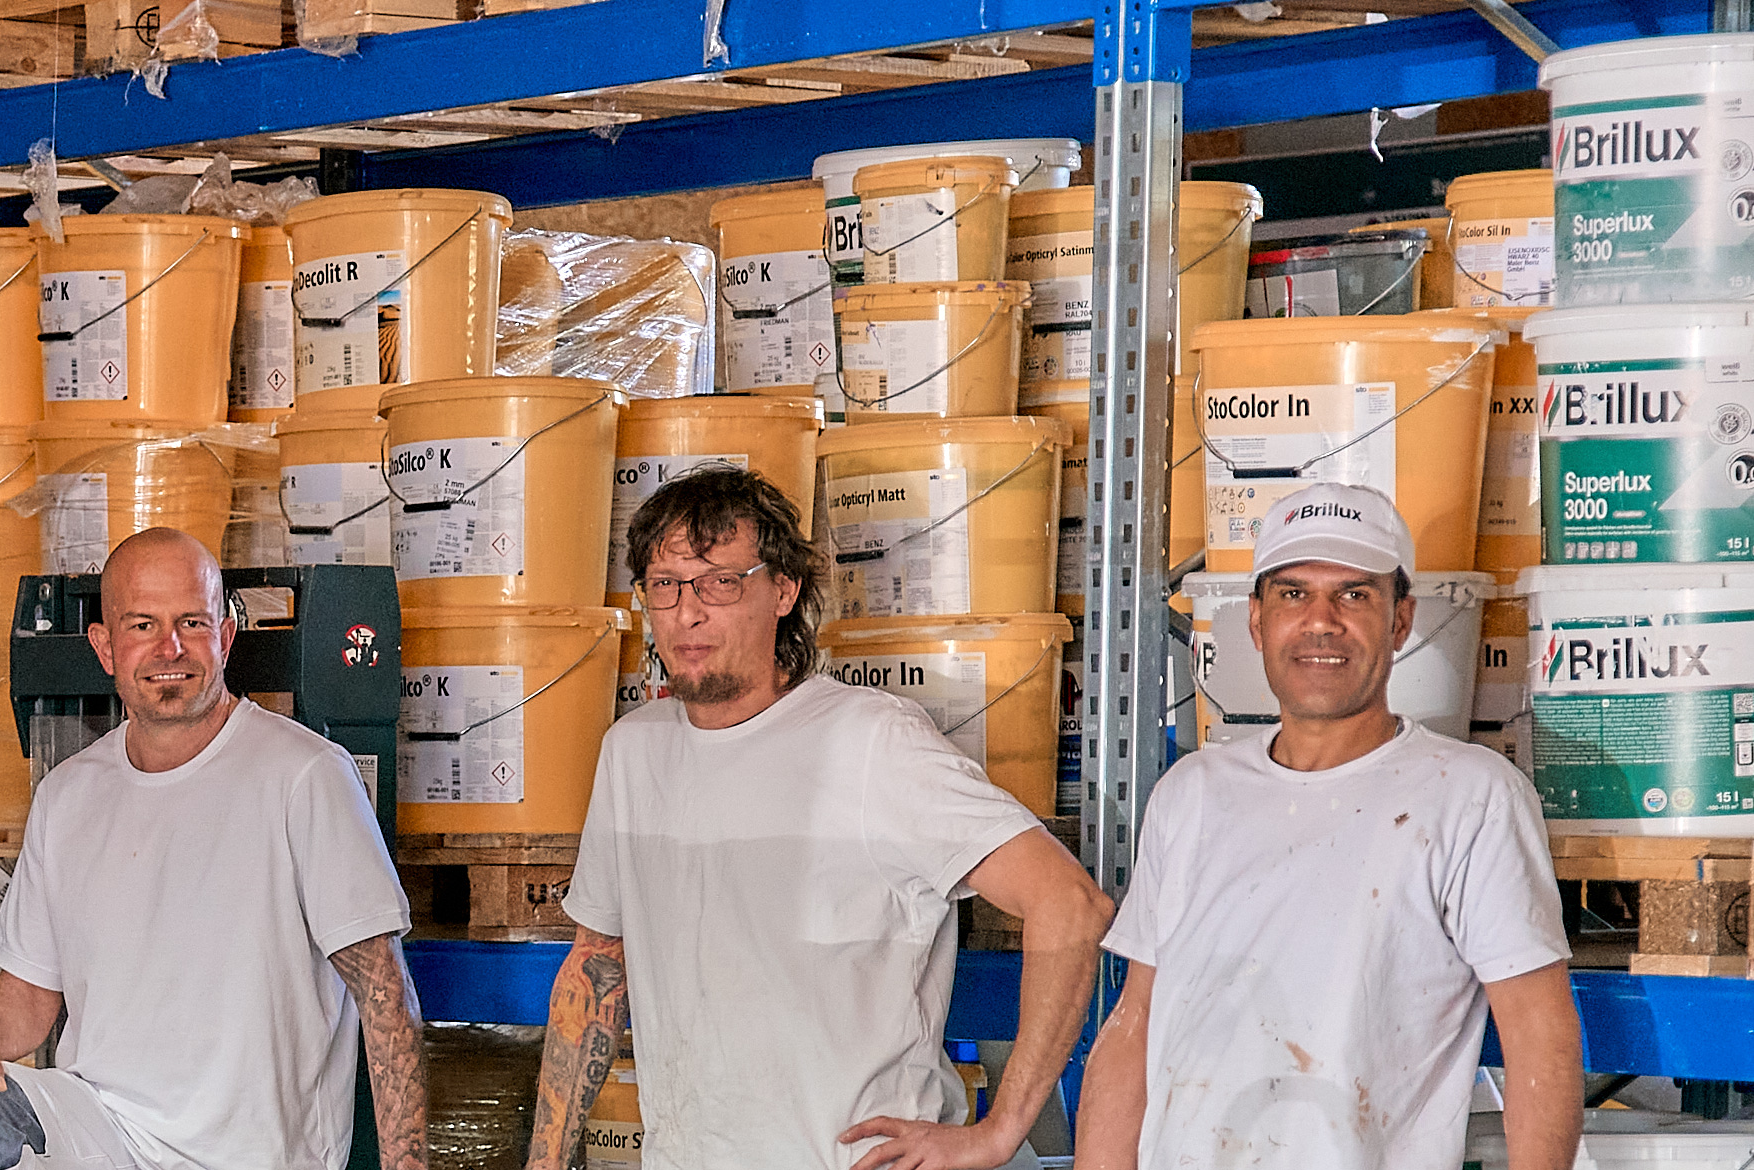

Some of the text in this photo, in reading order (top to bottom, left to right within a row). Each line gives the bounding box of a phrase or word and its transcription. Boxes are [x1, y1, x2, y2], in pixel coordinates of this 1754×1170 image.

[1574, 120, 1701, 168] Brillux
[1487, 225, 1498, 237] Sil
[1501, 225, 1511, 236] In
[1573, 211, 1654, 240] Superlux
[1026, 247, 1058, 261] Opticryl
[1573, 240, 1612, 263] 3000
[294, 261, 358, 292] Decolit R
[725, 261, 771, 288] Silco® K
[61, 281, 69, 300] K
[1066, 301, 1089, 310] BENZ
[1208, 394, 1310, 420] StoColor In
[1509, 397, 1538, 414] XX
[1565, 382, 1690, 426] Brillux
[440, 448, 451, 469] K
[614, 462, 650, 485] co®
[1564, 471, 1652, 497] Superlux
[841, 488, 906, 509] Opticryl Matt
[1564, 498, 1607, 521] 3000
[1300, 505, 1363, 523] Brillux
[865, 539, 885, 549] BENZ
[1727, 538, 1743, 549] 15
[1485, 644, 1507, 668] In
[1569, 637, 1711, 681] Brillux
[901, 661, 924, 686] In
[438, 676, 449, 697] K
[356, 758, 375, 766] rvice
[1716, 791, 1732, 803] 15
